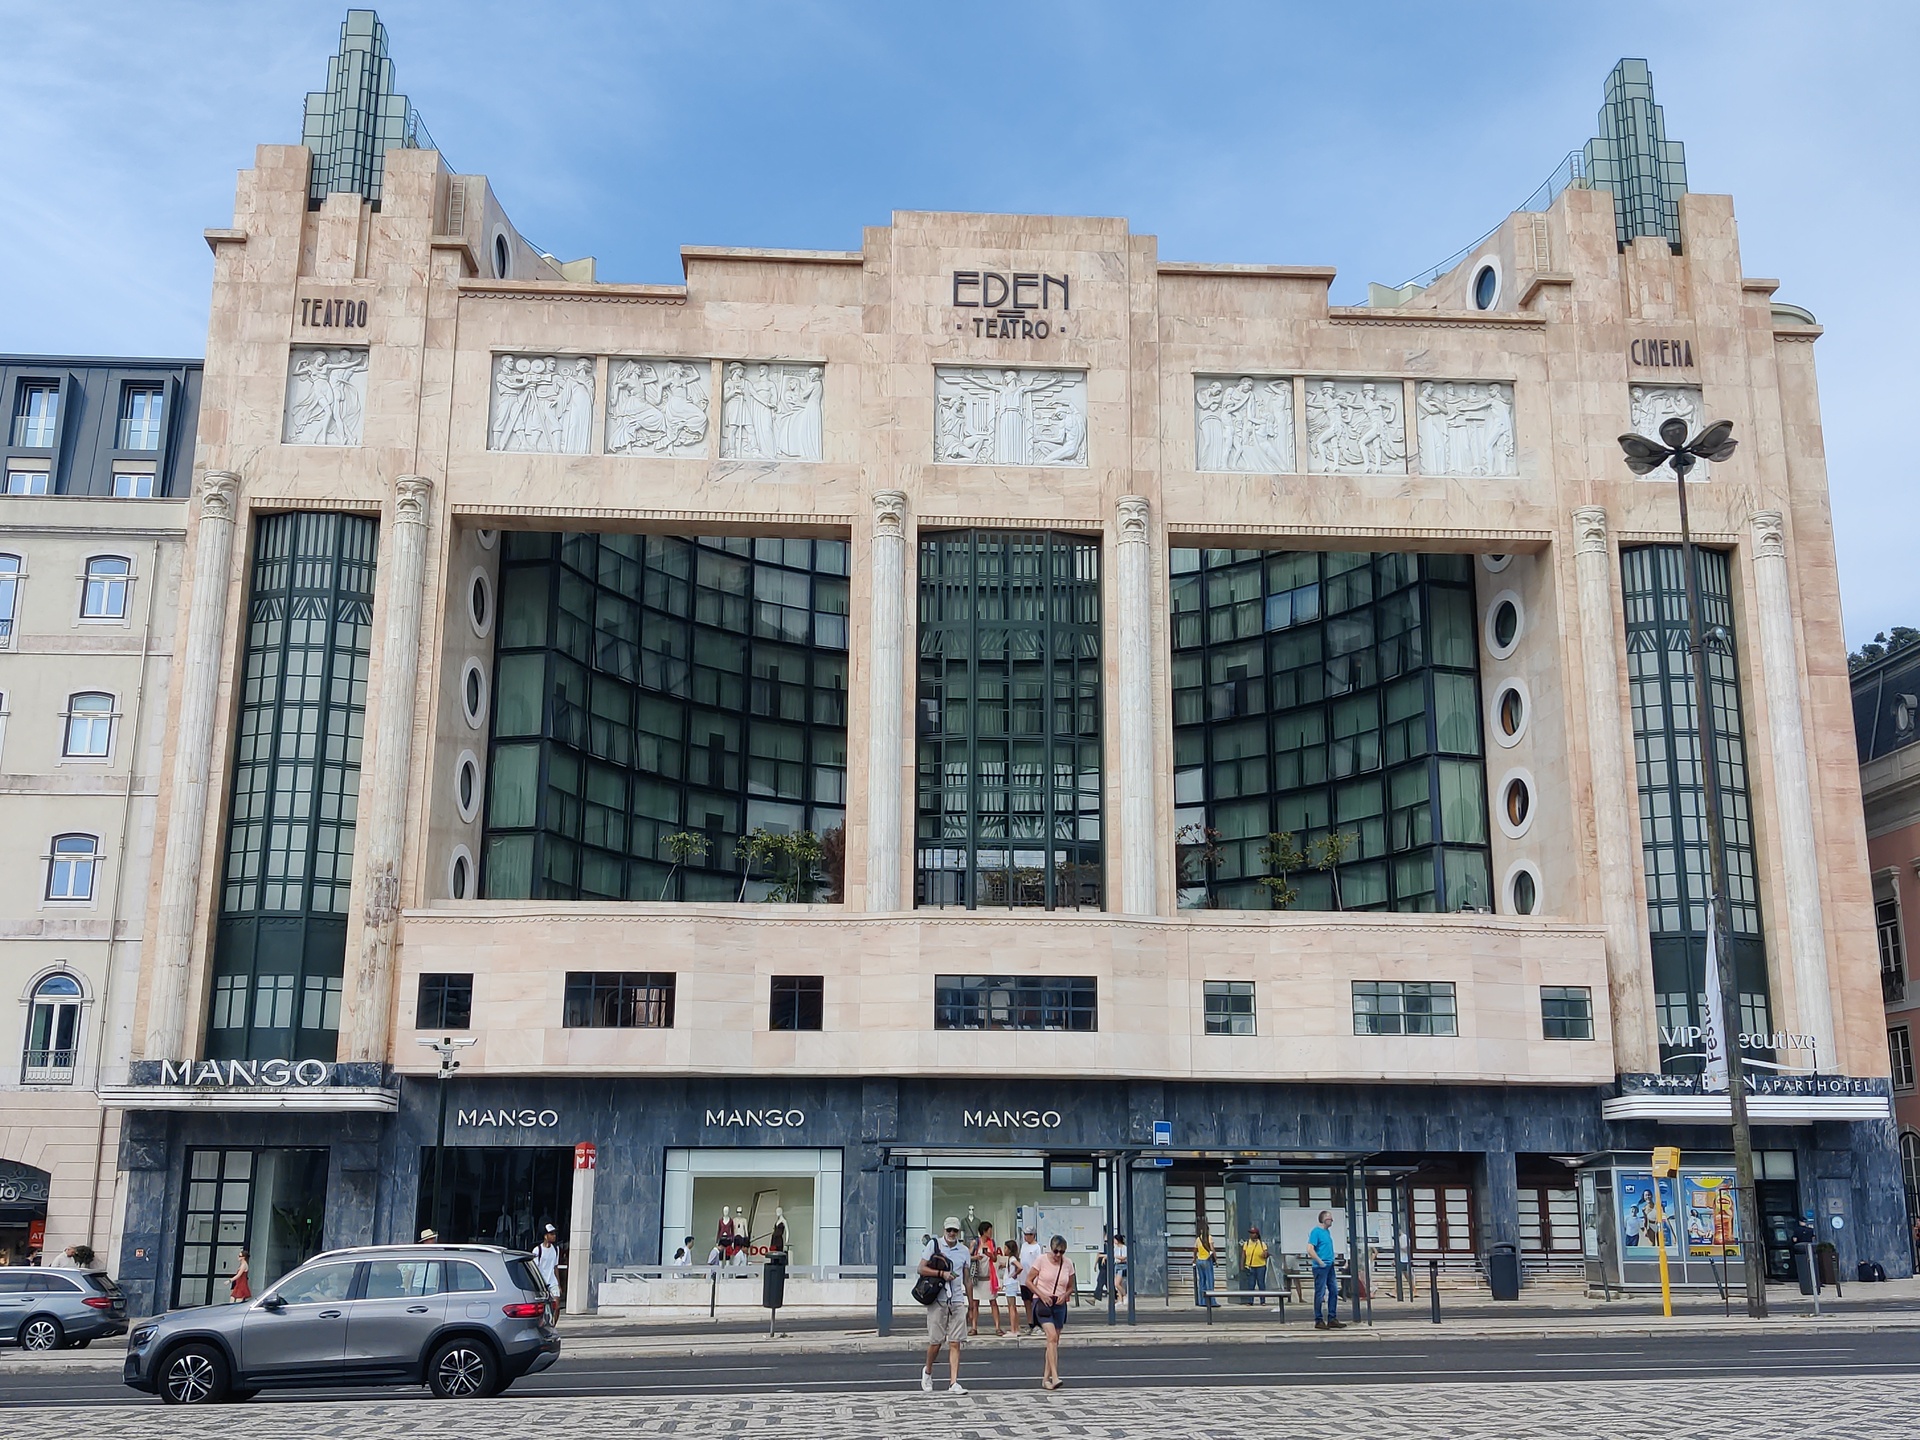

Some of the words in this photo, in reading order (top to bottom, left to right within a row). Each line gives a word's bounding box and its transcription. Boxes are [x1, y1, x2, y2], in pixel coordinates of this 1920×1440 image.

[953, 271, 1069, 310] EDEN
[301, 298, 368, 328] TEATRO
[972, 317, 1050, 340] TEATRO
[1630, 338, 1694, 368] CINEMA
[1660, 1025, 1702, 1048] VIP
[160, 1058, 328, 1087] MANGO
[1761, 1079, 1872, 1092] APARTHOTEL
[457, 1109, 559, 1127] MANGO
[705, 1109, 805, 1127] MANGO
[963, 1110, 1061, 1128] MANGO
